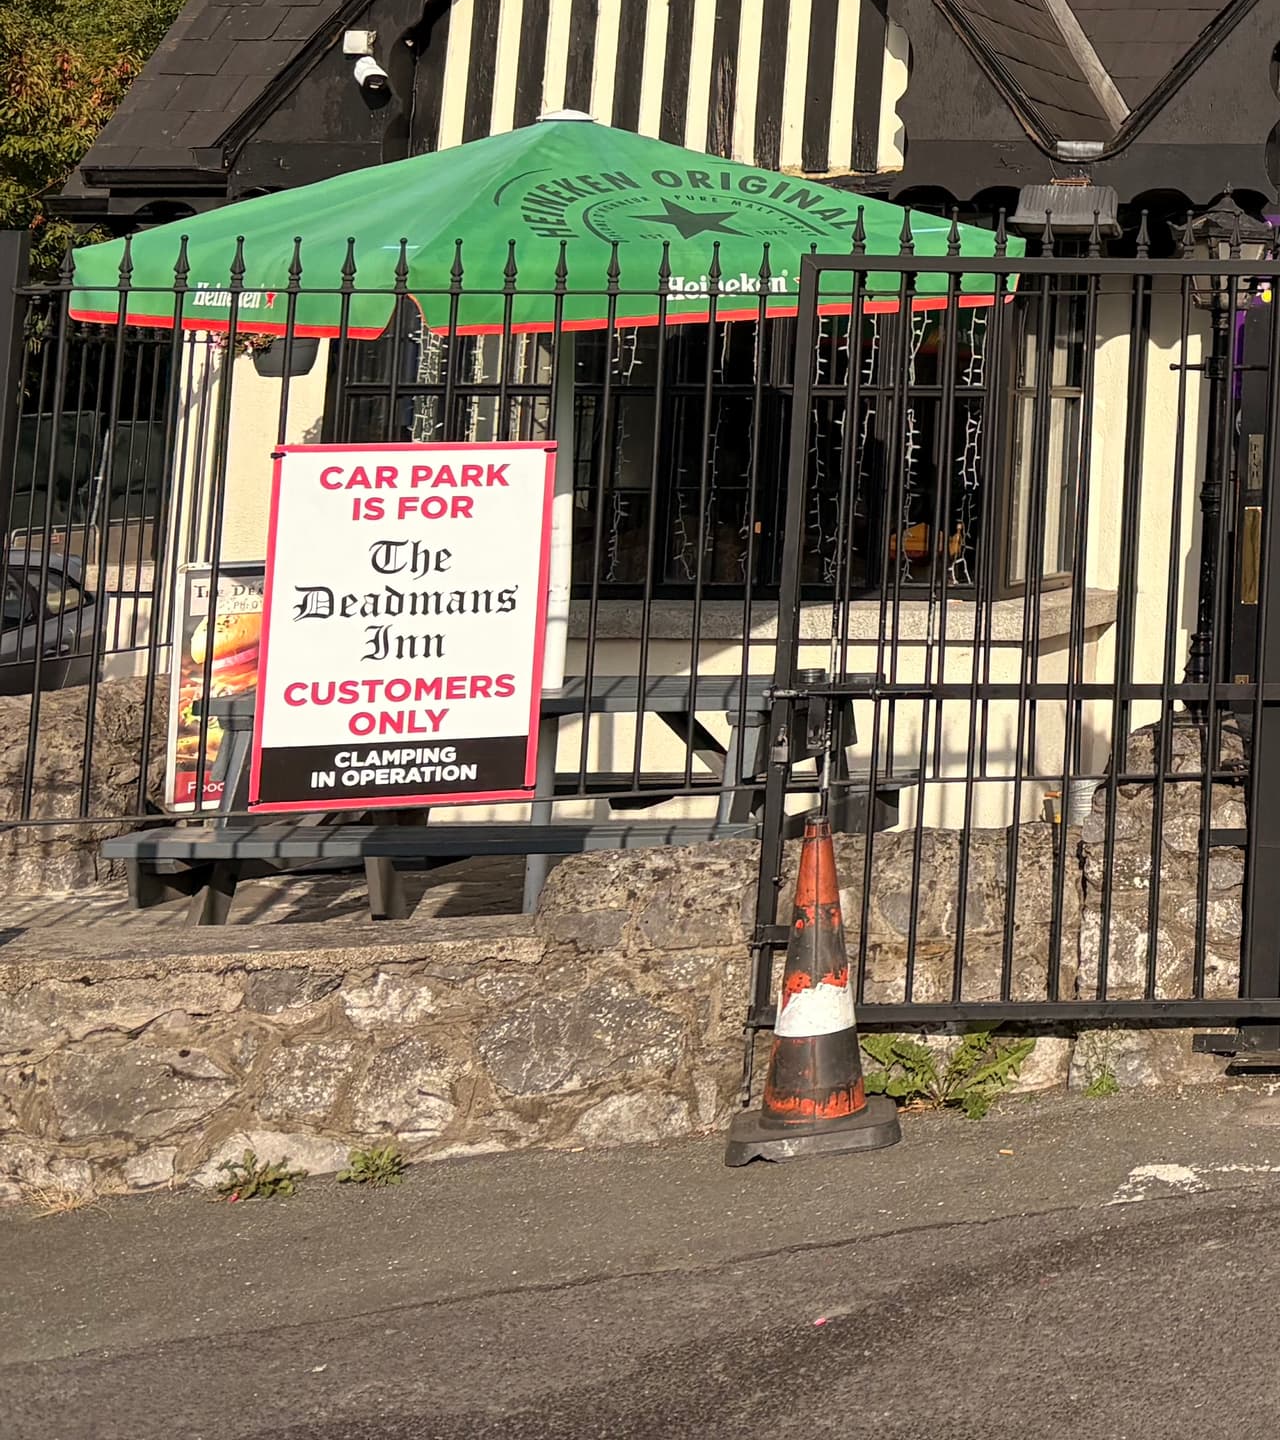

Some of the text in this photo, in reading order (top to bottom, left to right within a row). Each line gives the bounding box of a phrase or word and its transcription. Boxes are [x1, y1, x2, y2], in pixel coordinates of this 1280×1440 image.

[520, 171, 643, 239] HEINEKEN
[651, 169, 858, 231] ORIGINAL
[731, 199, 774, 215] MALT
[320, 464, 510, 490] CAR PARK
[353, 496, 473, 520] IS FOR
[369, 540, 451, 580] The
[293, 584, 519, 623] Deadmans
[361, 625, 444, 661] Inn
[283, 673, 516, 707] CUSTOMERS
[348, 708, 450, 737] ONLY
[334, 746, 457, 769] CLAMPING
[311, 763, 478, 788] IN OPERATION
